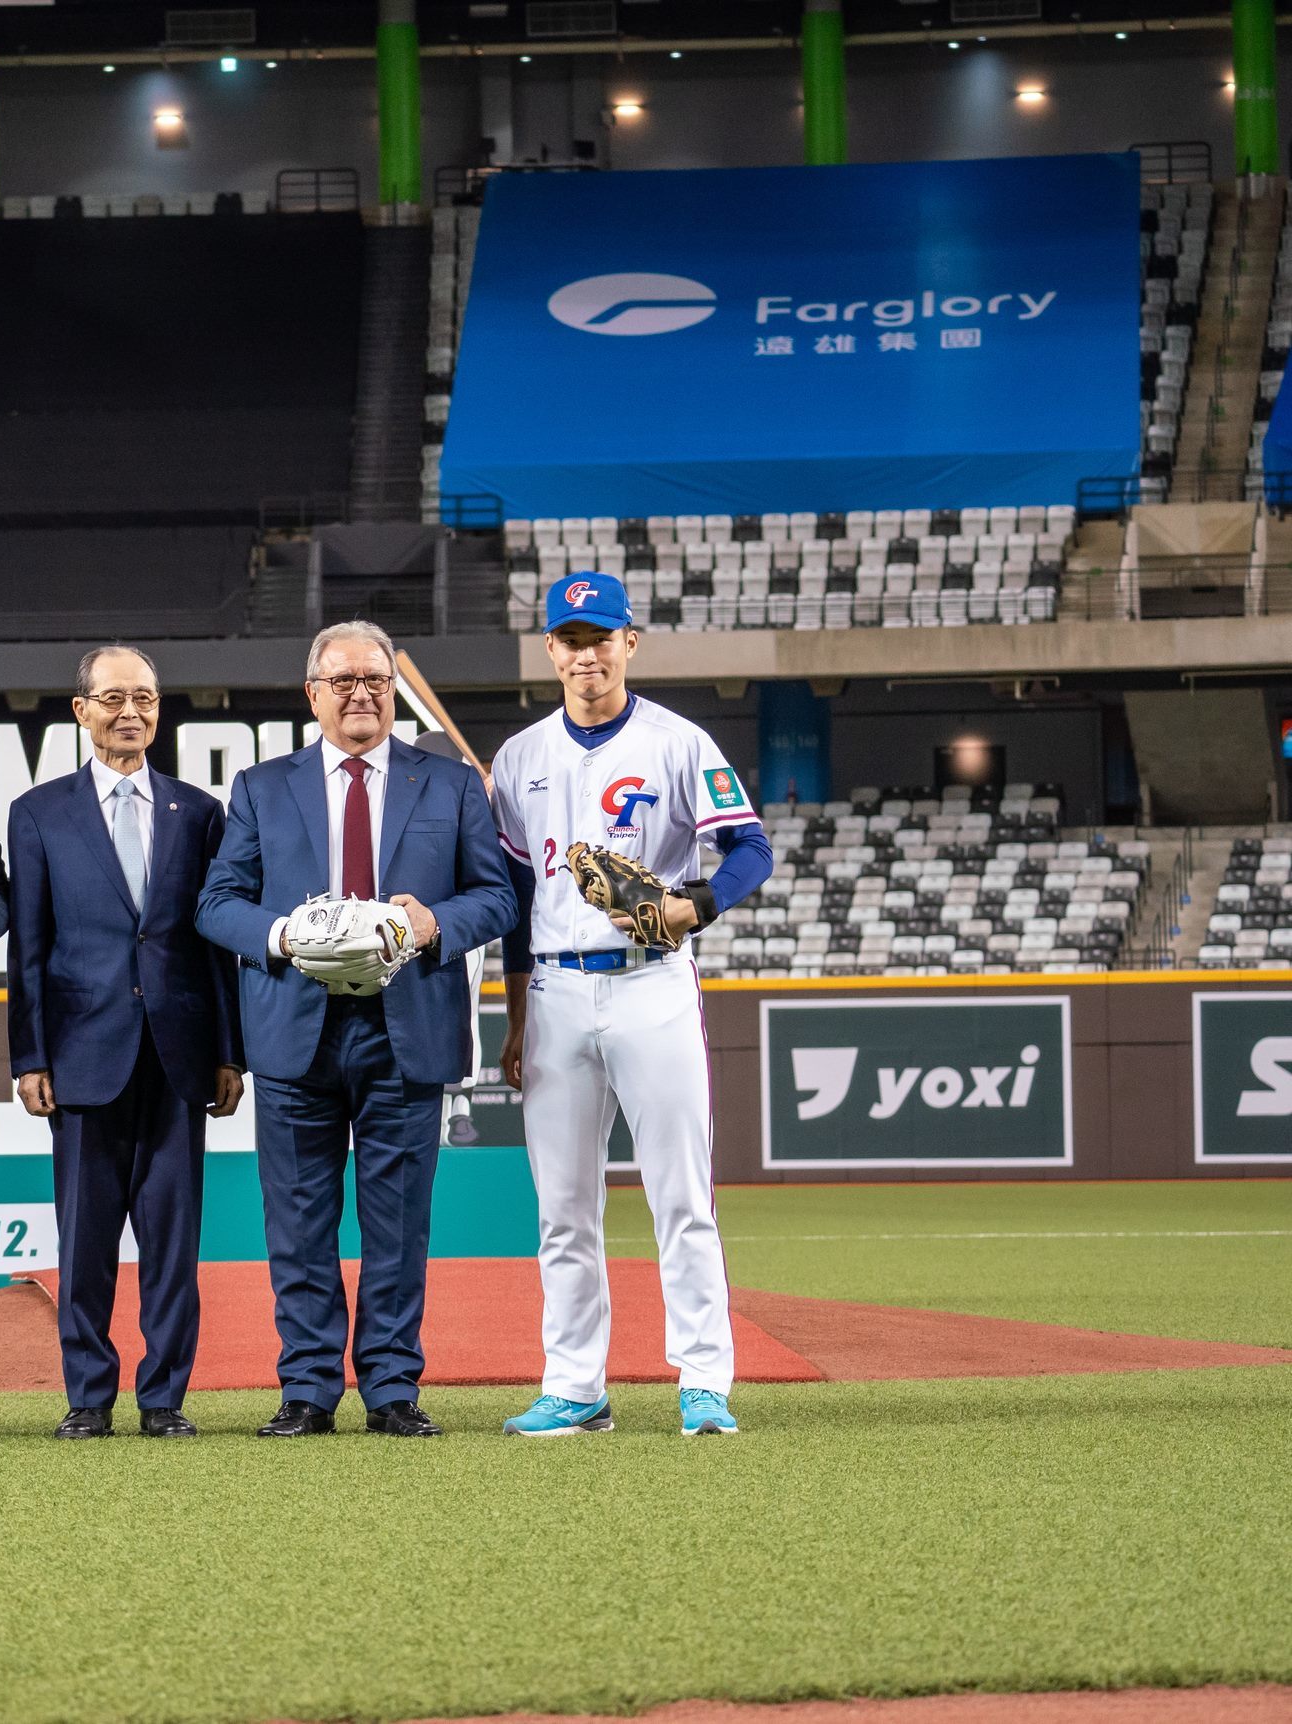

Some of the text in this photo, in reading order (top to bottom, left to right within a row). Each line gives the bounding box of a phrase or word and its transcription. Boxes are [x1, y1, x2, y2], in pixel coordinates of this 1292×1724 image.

[755, 290, 1057, 327] Farglory
[754, 328, 982, 356] 遠雄集團
[606, 825, 641, 833] Chinese
[868, 1044, 1041, 1120] yoxi
